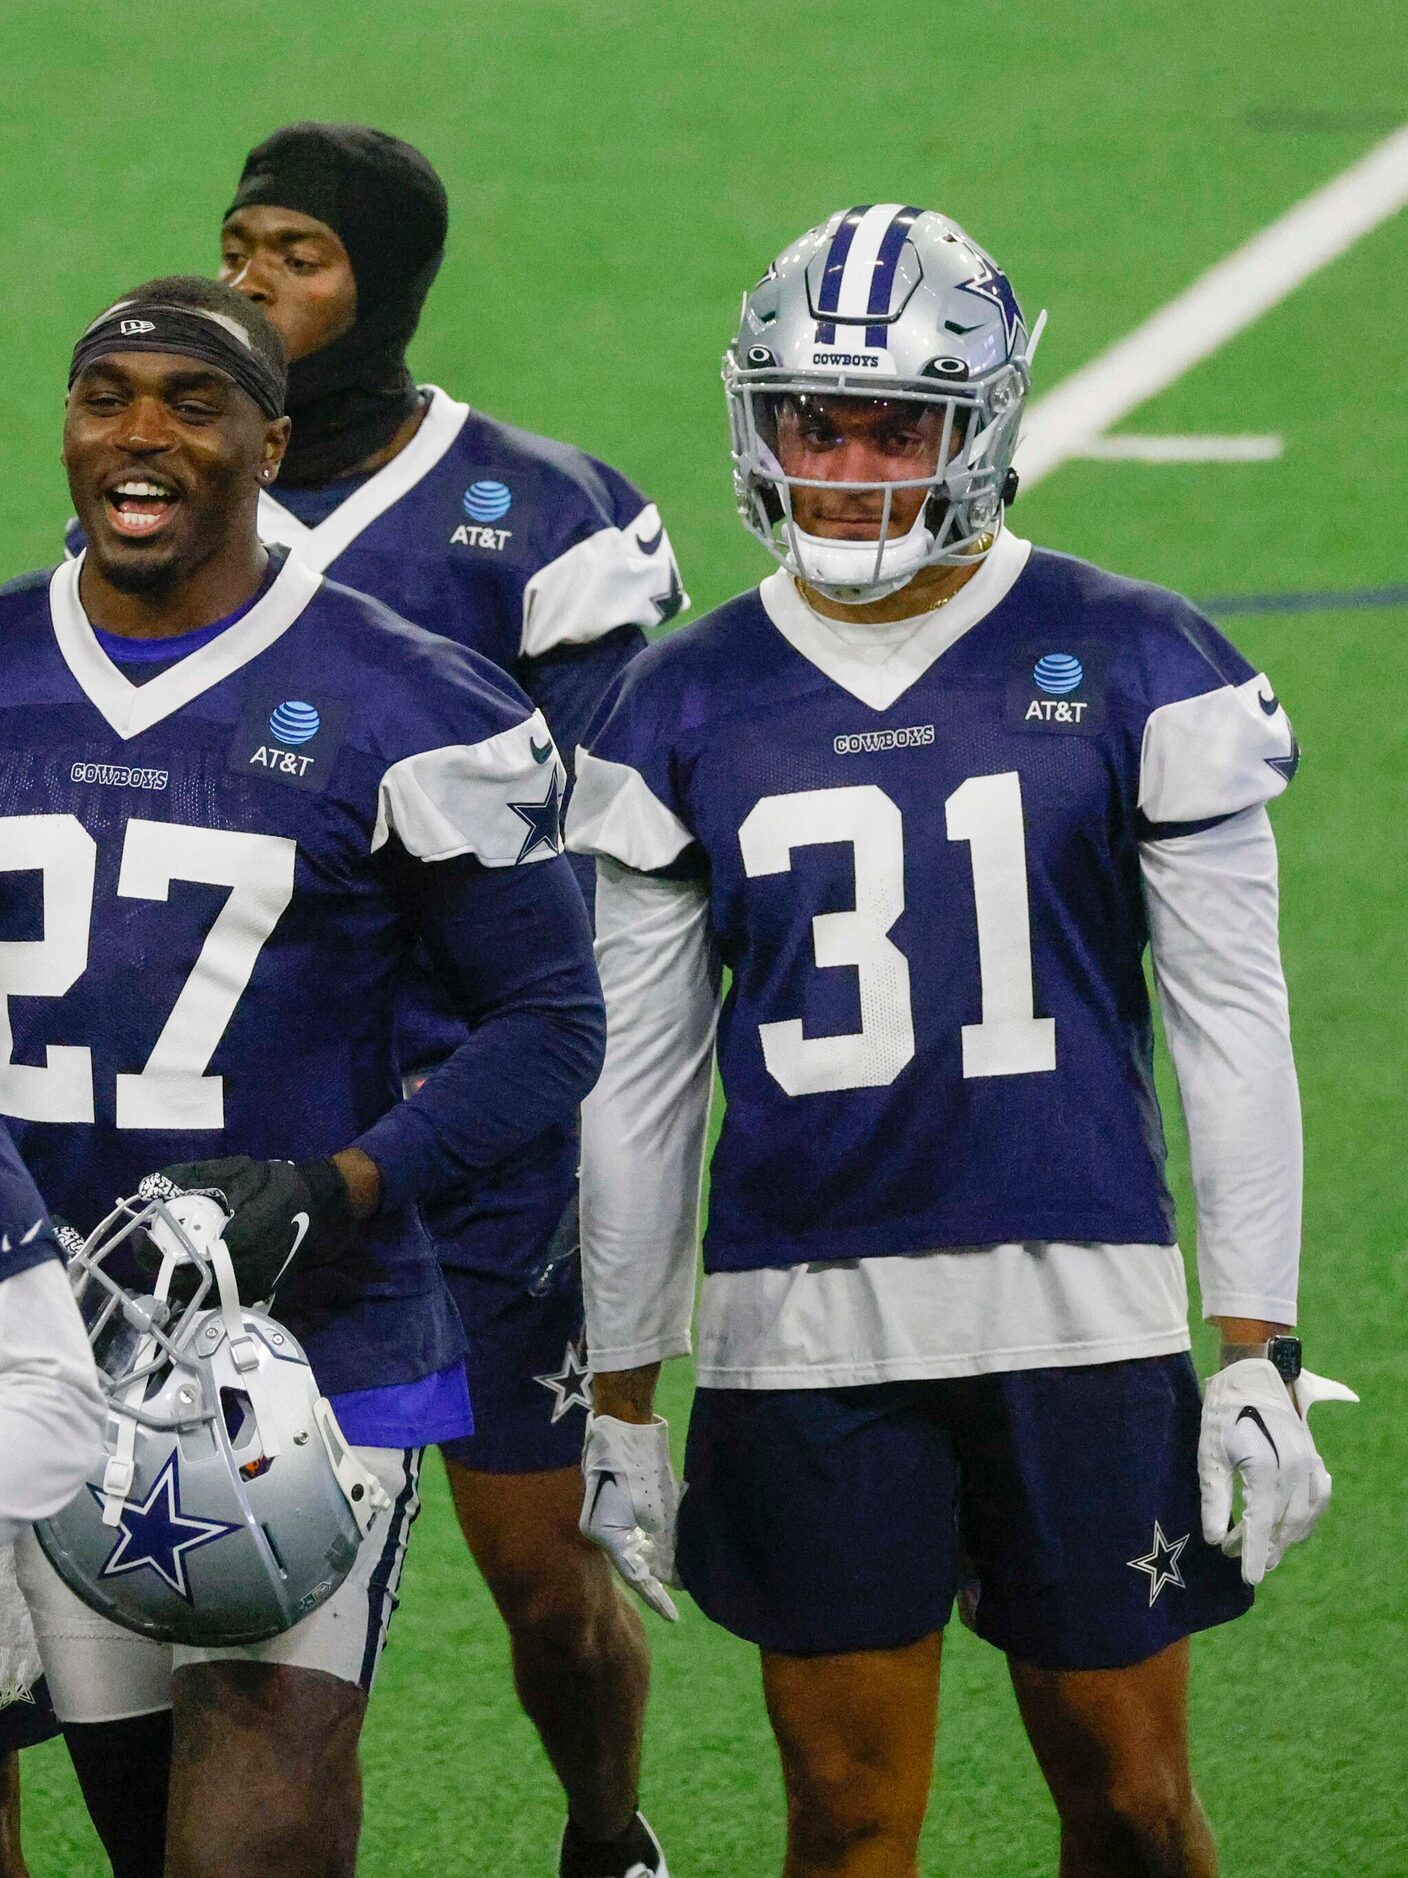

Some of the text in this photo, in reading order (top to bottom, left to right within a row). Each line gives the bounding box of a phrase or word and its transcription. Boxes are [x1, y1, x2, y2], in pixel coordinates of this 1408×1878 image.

[812, 353, 879, 368] COWBOYS
[449, 524, 513, 551] AT&T
[1024, 700, 1087, 723] AT&T
[833, 724, 935, 754] COWBOYS
[249, 745, 315, 777] AT&T
[70, 762, 169, 790] COWBOYS
[737, 770, 1057, 1097] 31
